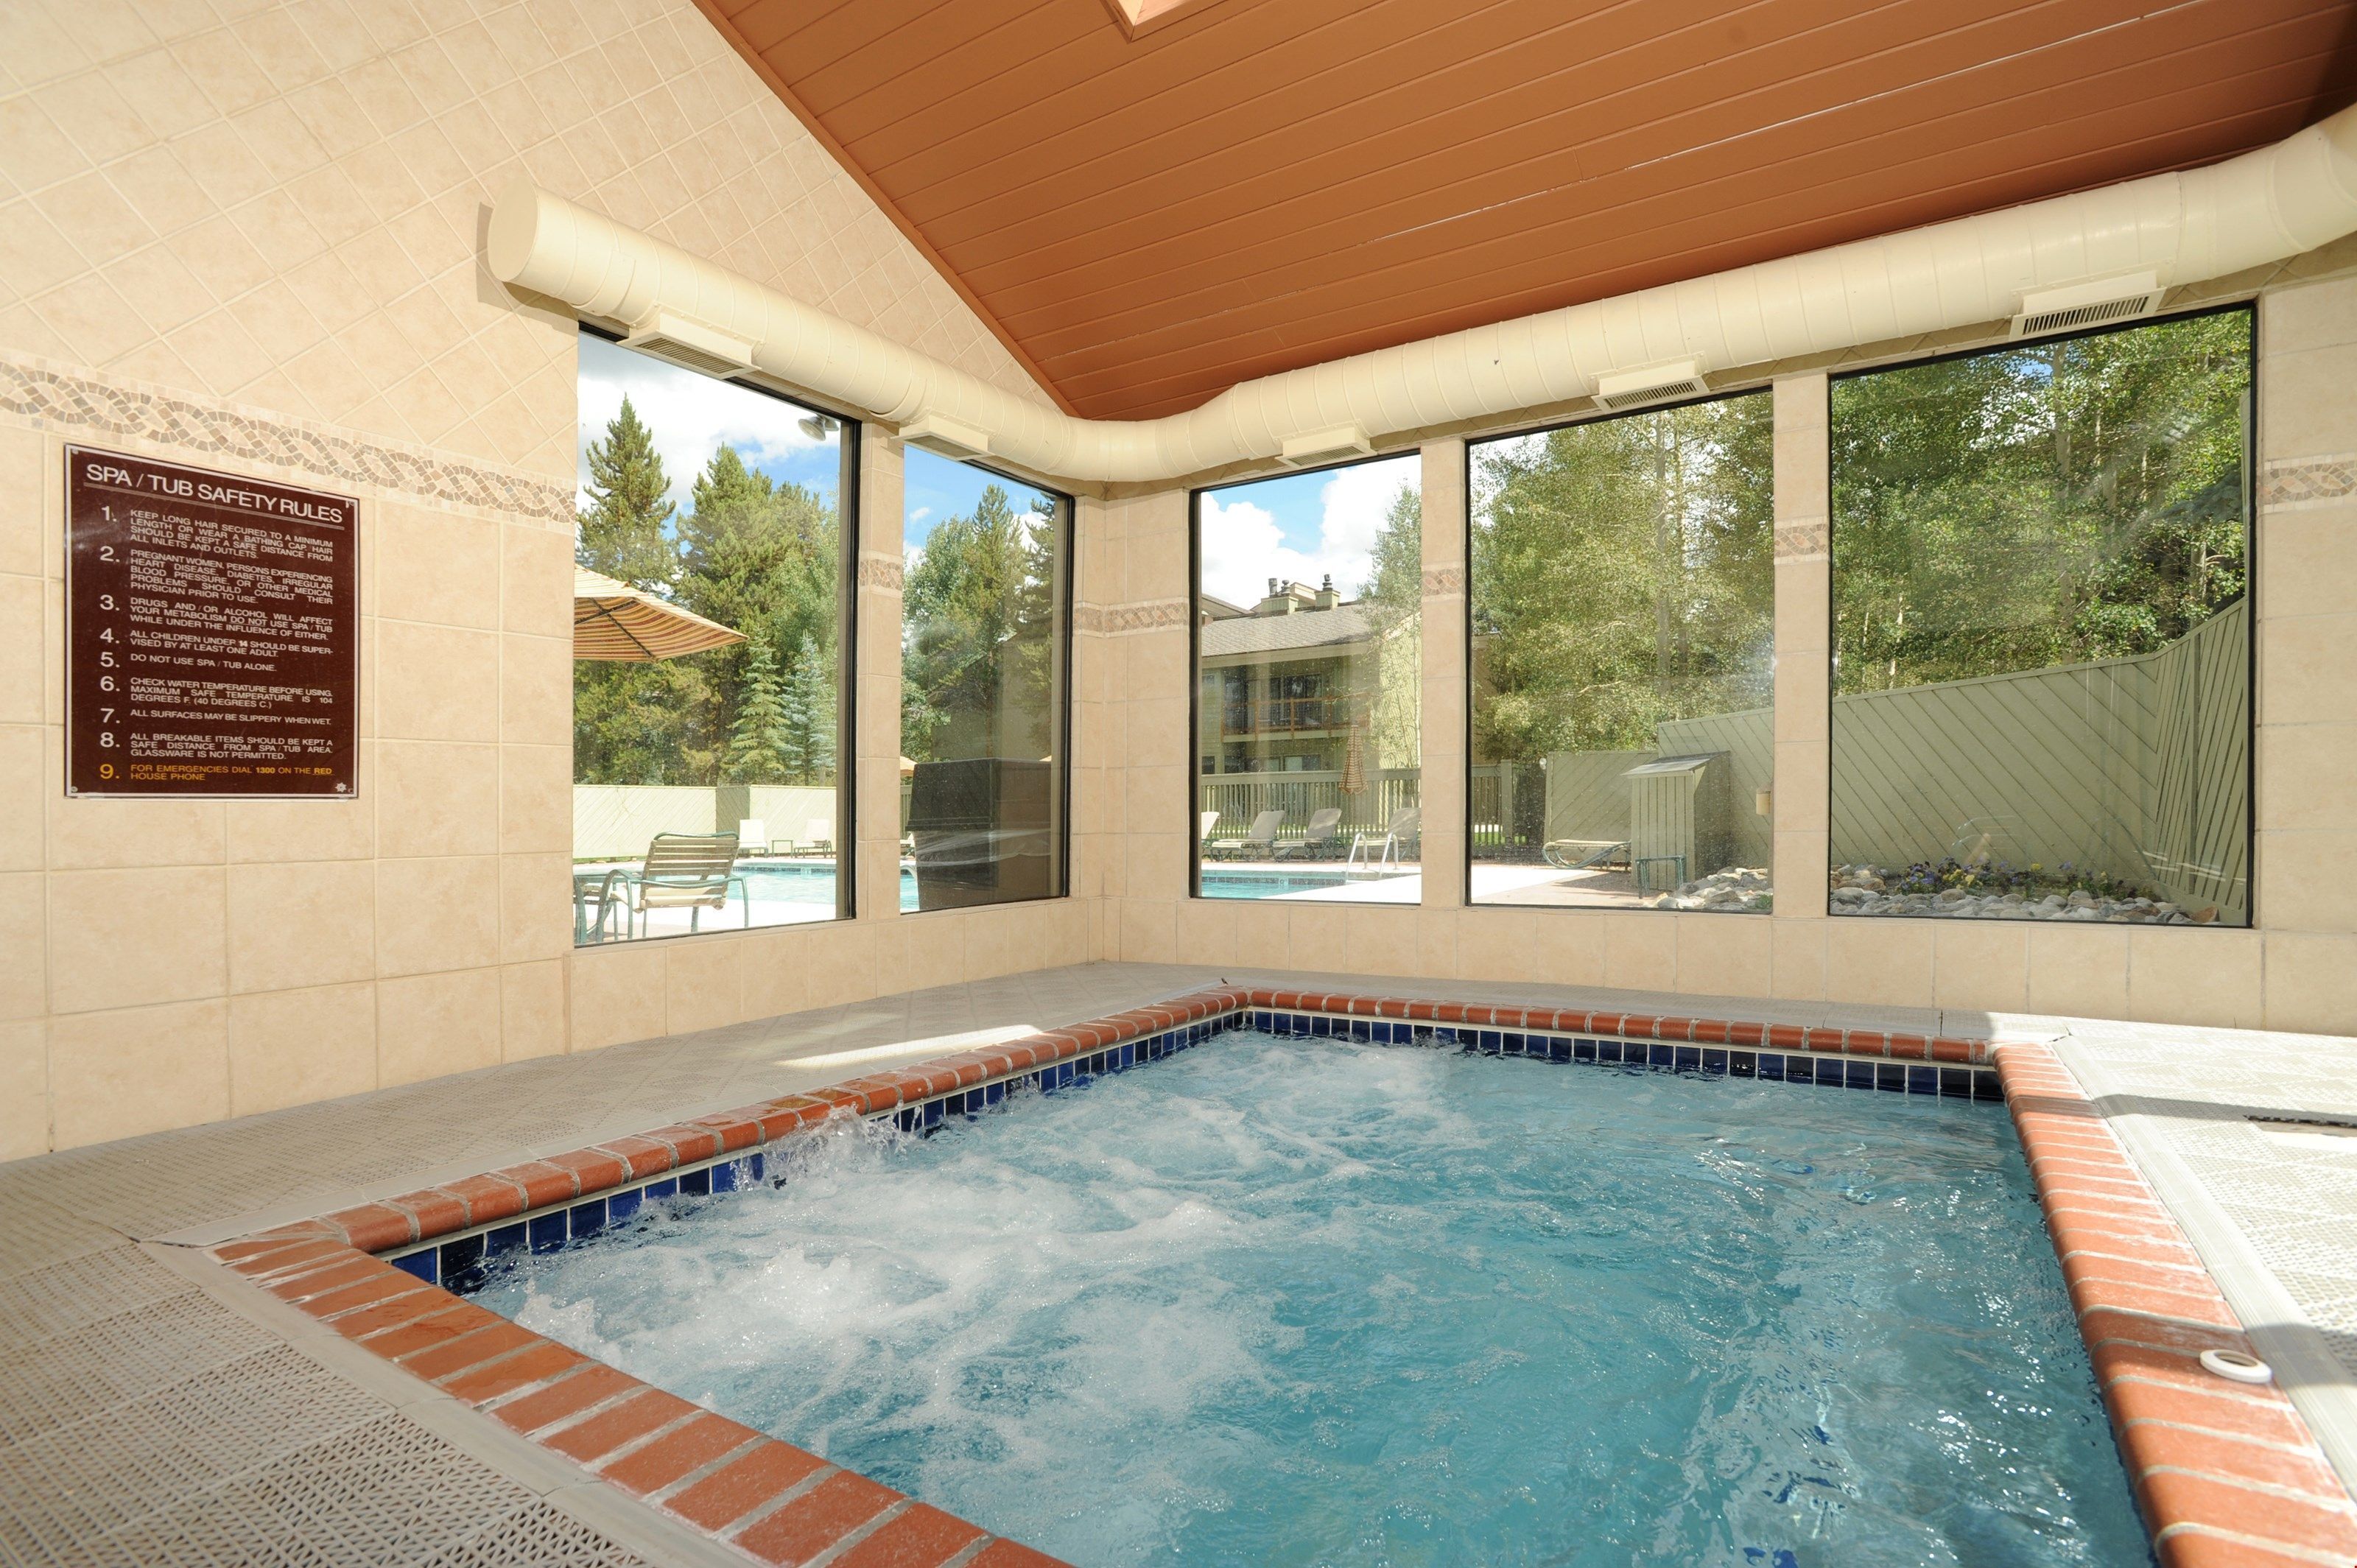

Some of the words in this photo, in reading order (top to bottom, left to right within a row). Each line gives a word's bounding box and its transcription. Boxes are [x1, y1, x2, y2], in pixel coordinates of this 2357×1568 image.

[197, 483, 277, 512] SAFETY
[280, 499, 342, 523] RULES
[101, 504, 116, 521] 1.
[130, 509, 158, 520] KEEP
[162, 514, 190, 525] LONG
[194, 519, 217, 530] HAIR
[222, 524, 267, 537] SECURED
[269, 531, 282, 540] TO
[294, 535, 332, 547] MINIMUM
[130, 517, 172, 530] LENGTH
[178, 524, 193, 533] OR
[198, 527, 227, 539] WEAR
[244, 535, 283, 547] BATHING
[312, 545, 332, 555] HAIR
[130, 533, 149, 543] ALL
[152, 536, 187, 548] INLETS
[190, 542, 211, 552] AND
[130, 525, 173, 538] SHOULD
[178, 532, 191, 541] BE
[194, 535, 220, 545] KEPT
[233, 541, 257, 551] SAFE
[261, 545, 303, 558] DISTANCE
[307, 552, 332, 562] FROM
[100, 545, 119, 563] 2.
[130, 549, 184, 563] PREGNANT
[226, 562, 269, 574] PERSONS
[270, 569, 332, 583] EXPERIENCING
[130, 558, 165, 569] HEART
[282, 577, 332, 590] IRREGULAR
[130, 566, 166, 577] BLOOD
[236, 579, 250, 587] OR
[257, 582, 288, 592] OTHER
[295, 586, 332, 597] MEDICAL
[130, 574, 187, 587] PROBLEMS
[202, 582, 241, 594] SHOULD
[254, 588, 295, 600] CONSULT
[306, 595, 332, 605] THEIR
[130, 582, 185, 595] PHYSICIAN
[188, 588, 219, 599] PRIOR
[221, 592, 234, 601] TO
[100, 594, 119, 611] 3.
[130, 597, 168, 608] DRUGS
[224, 607, 267, 619] ALCOHOL
[273, 613, 294, 621] WILL
[299, 616, 332, 625] AFFECT
[130, 605, 159, 615] YOUR
[164, 608, 226, 622] METABOLISM
[247, 617, 267, 626] NOT
[270, 619, 288, 627] USE
[130, 614, 162, 624] WHILE
[166, 617, 201, 627] UNDER
[203, 621, 222, 630] THE
[225, 623, 277, 635] INFLUENCE
[100, 627, 119, 644] 4.
[130, 630, 148, 638] ALL
[150, 631, 200, 643] CHILDREN
[250, 641, 286, 650] SHOULD
[301, 645, 333, 654] SUPER-
[130, 638, 161, 647] VISED
[164, 641, 178, 649] BY
[194, 643, 224, 653] LEAST
[226, 646, 247, 654] ONE
[100, 651, 119, 668] 5.
[130, 653, 146, 661] DO
[150, 655, 171, 664] NOT
[173, 657, 193, 665] USE
[100, 675, 119, 692] 6.
[130, 677, 165, 686] CHECK
[167, 680, 199, 689] WATER
[201, 682, 267, 692] TEMPERATURE
[269, 686, 303, 695] BEFORE
[130, 685, 180, 695] MAXIMUM
[191, 689, 215, 697] SAFE
[225, 691, 293, 701] TEMPERATURE
[130, 693, 180, 703] DEGREES
[211, 697, 256, 707] DEGREES
[100, 708, 119, 723] 7.
[130, 709, 148, 717] ALL
[150, 710, 203, 719] SURFACES
[204, 712, 223, 720] MAY
[239, 714, 281, 723] SLIPPERY
[284, 716, 311, 724] WHEN
[100, 731, 119, 748] 8.
[152, 734, 211, 742] BREAKABLE
[215, 735, 244, 743] ITEMS
[166, 742, 215, 750] DISTANCE
[130, 748, 194, 757] GLASSWARE
[100, 764, 119, 779] 9.
[156, 764, 228, 773] EMERGENCIES
